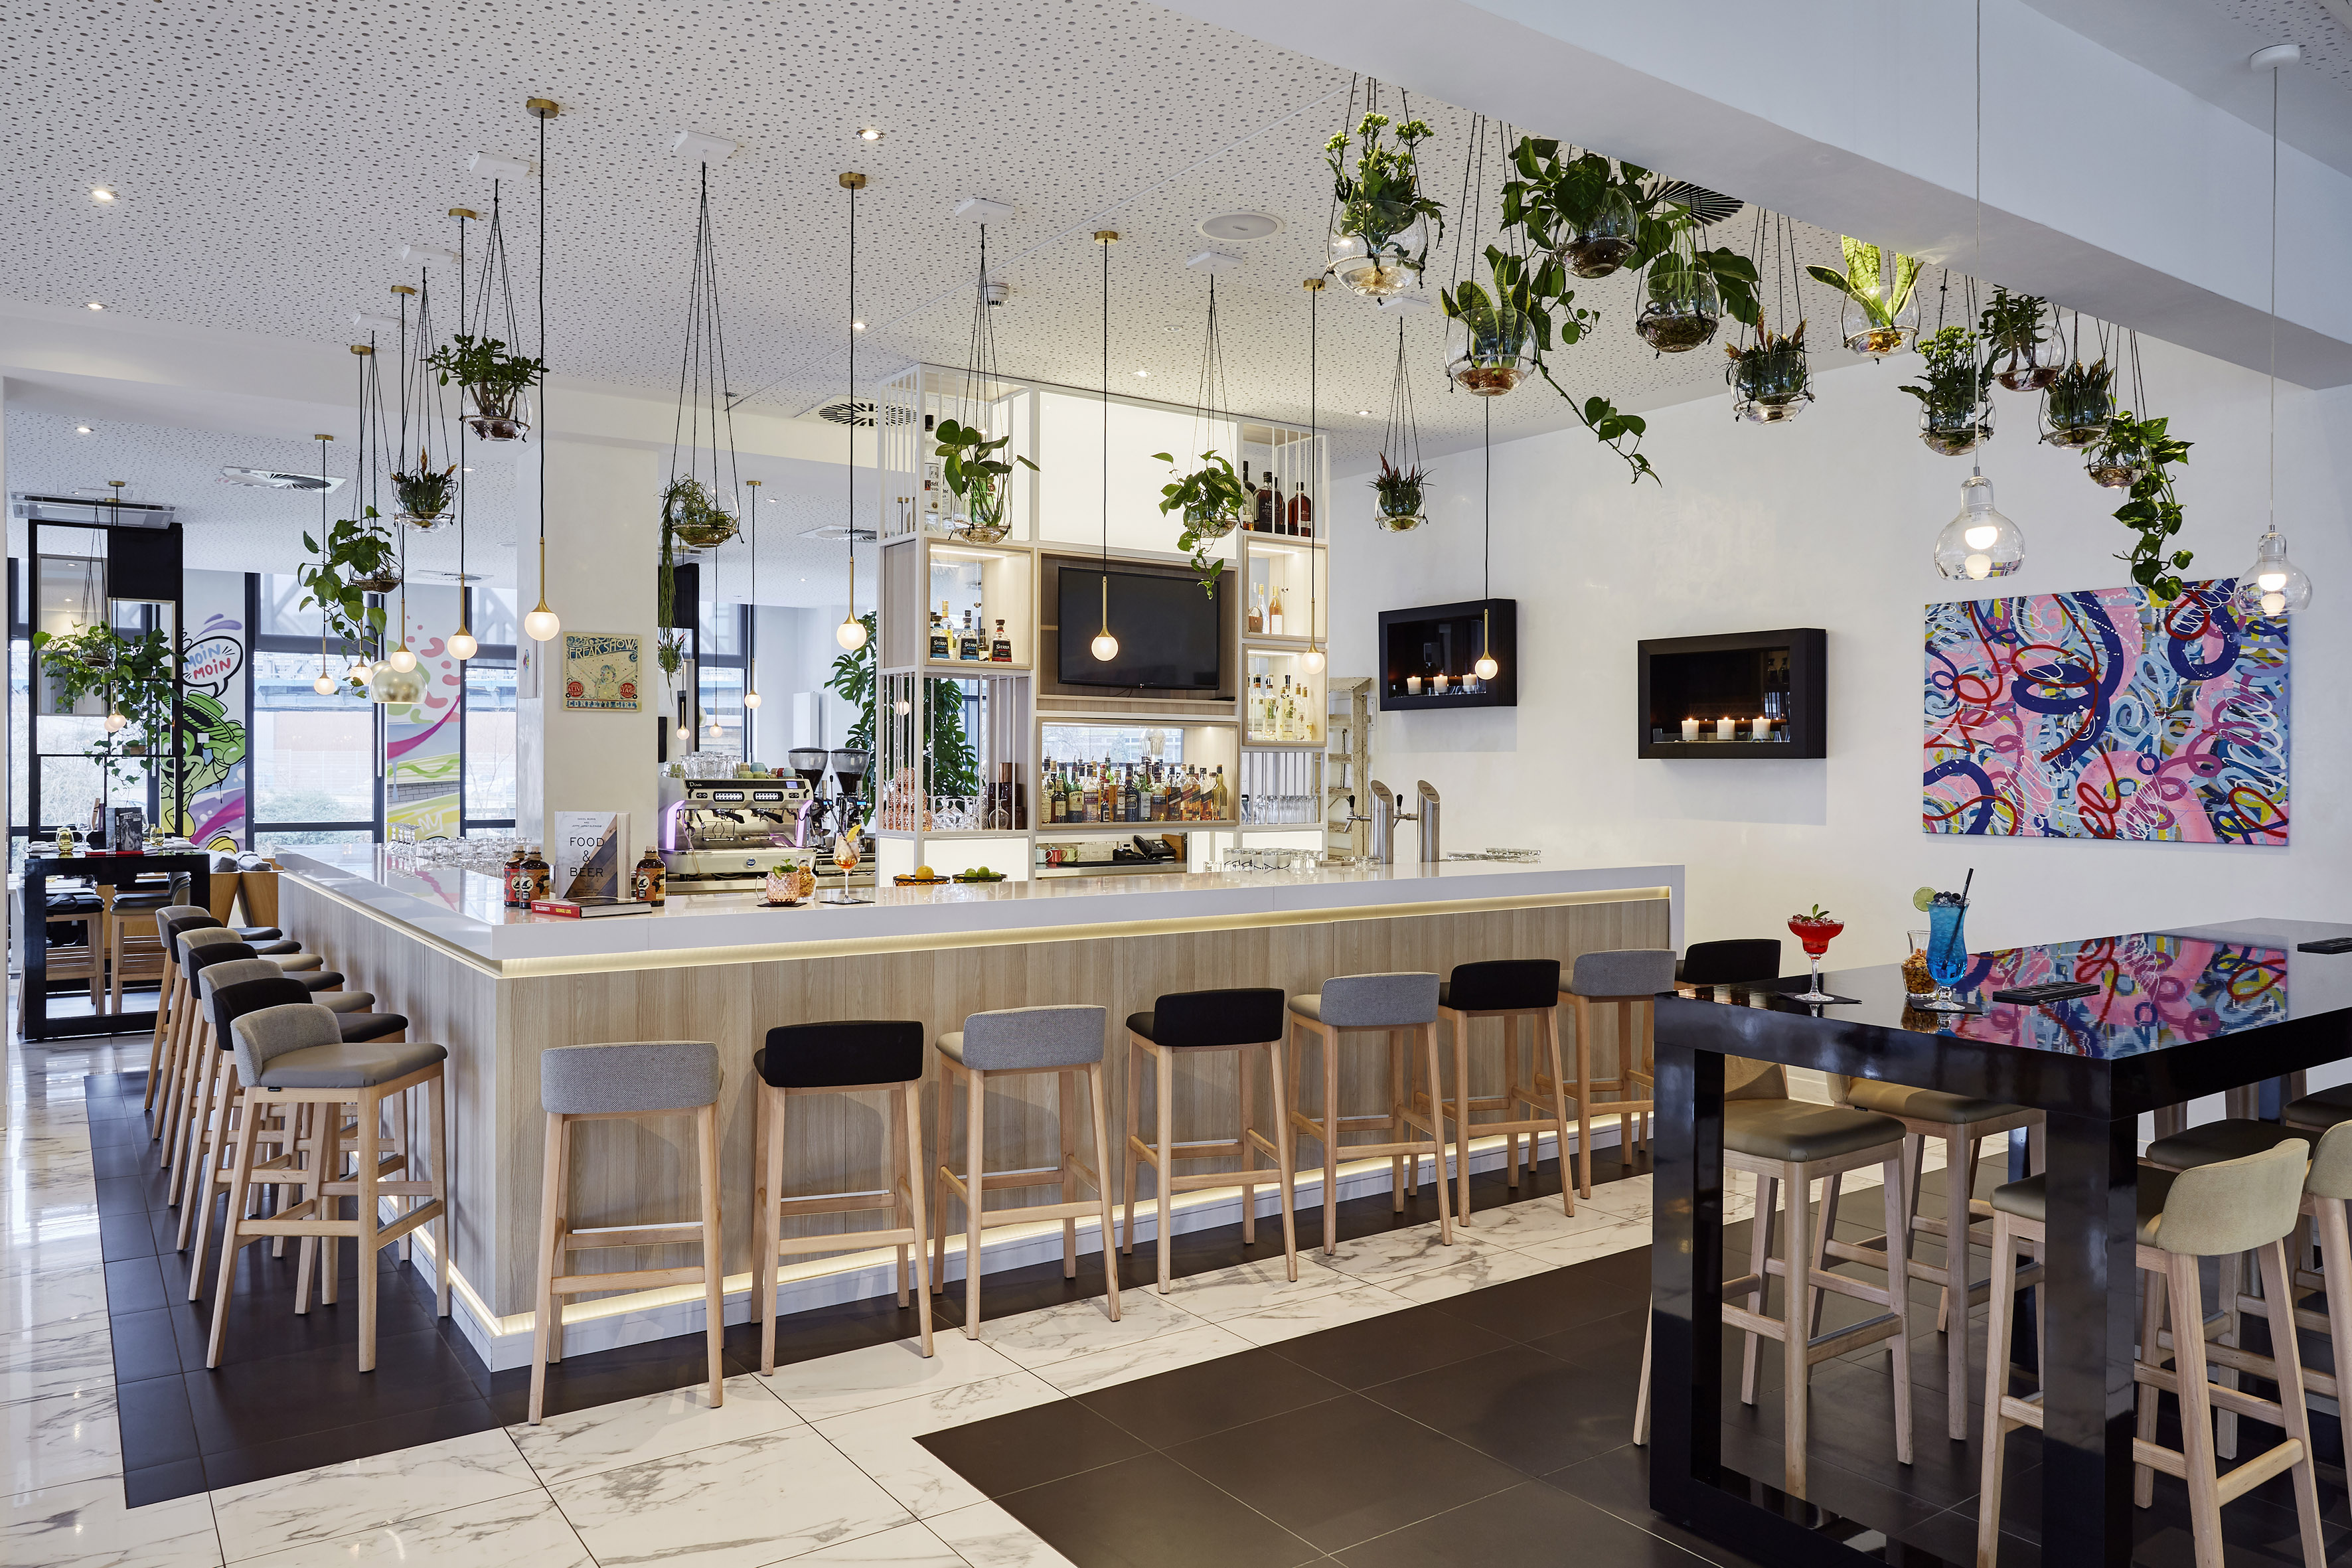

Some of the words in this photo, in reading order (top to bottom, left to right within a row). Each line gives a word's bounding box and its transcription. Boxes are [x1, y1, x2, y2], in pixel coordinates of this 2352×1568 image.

[569, 644, 602, 659] FREAK
[603, 639, 634, 653] SHOW
[570, 837, 605, 847] FOOD
[582, 850, 591, 862] &
[570, 867, 604, 877] BEER
